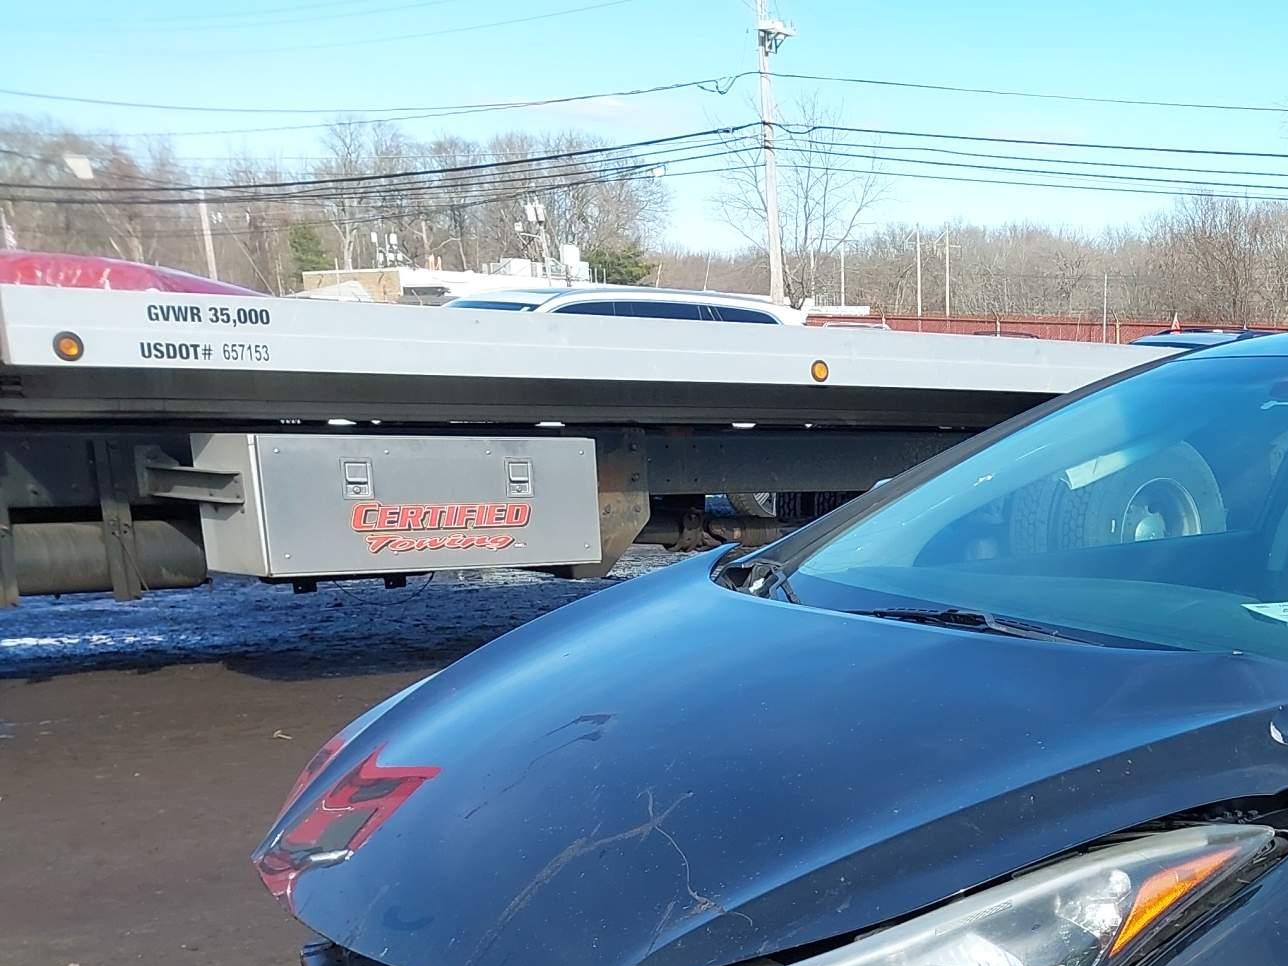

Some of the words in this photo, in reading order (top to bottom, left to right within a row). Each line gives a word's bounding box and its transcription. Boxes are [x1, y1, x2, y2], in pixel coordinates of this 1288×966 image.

[147, 304, 202, 322] GVWR
[208, 306, 270, 327] 35,000
[140, 341, 213, 360] USDOT#
[222, 343, 270, 361] 657153
[352, 501, 531, 532] CERTIFIED
